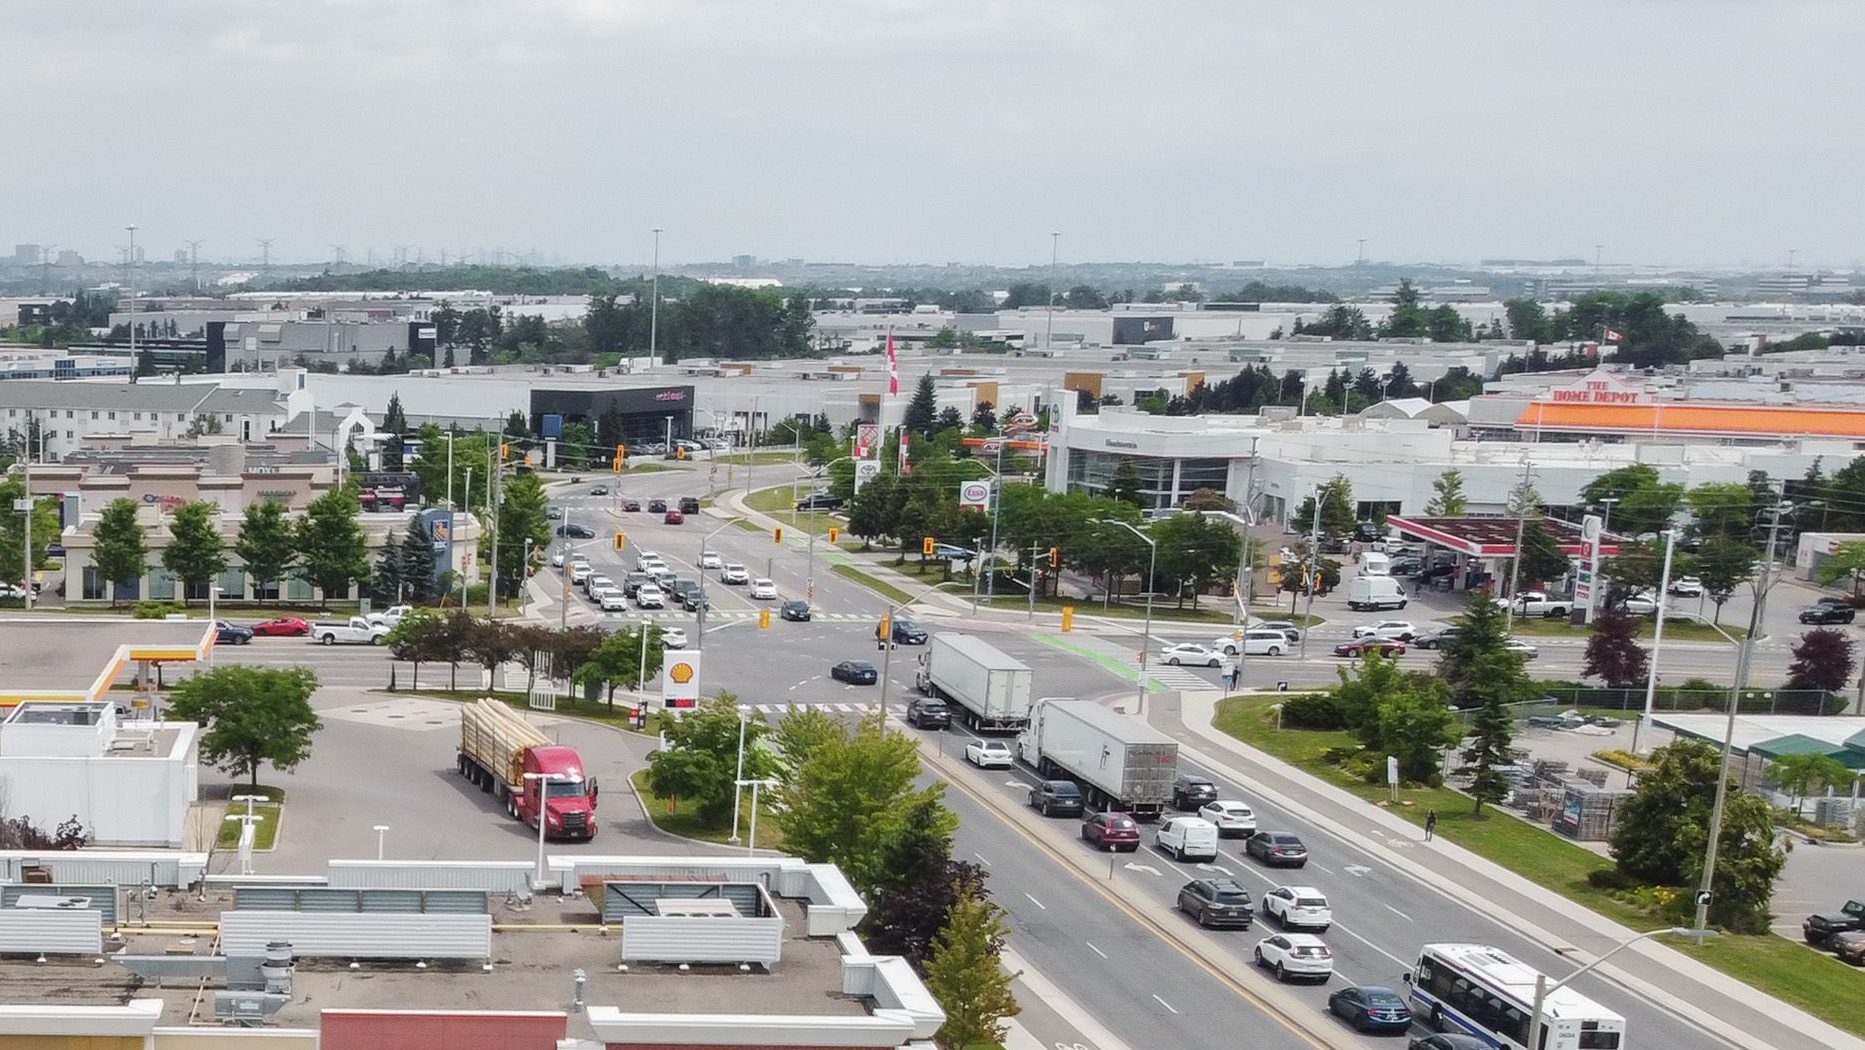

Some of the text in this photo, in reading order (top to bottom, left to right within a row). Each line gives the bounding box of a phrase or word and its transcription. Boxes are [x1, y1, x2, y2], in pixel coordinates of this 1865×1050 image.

[1586, 382, 1609, 390] THE
[1554, 391, 1638, 403] HOME DEPOT
